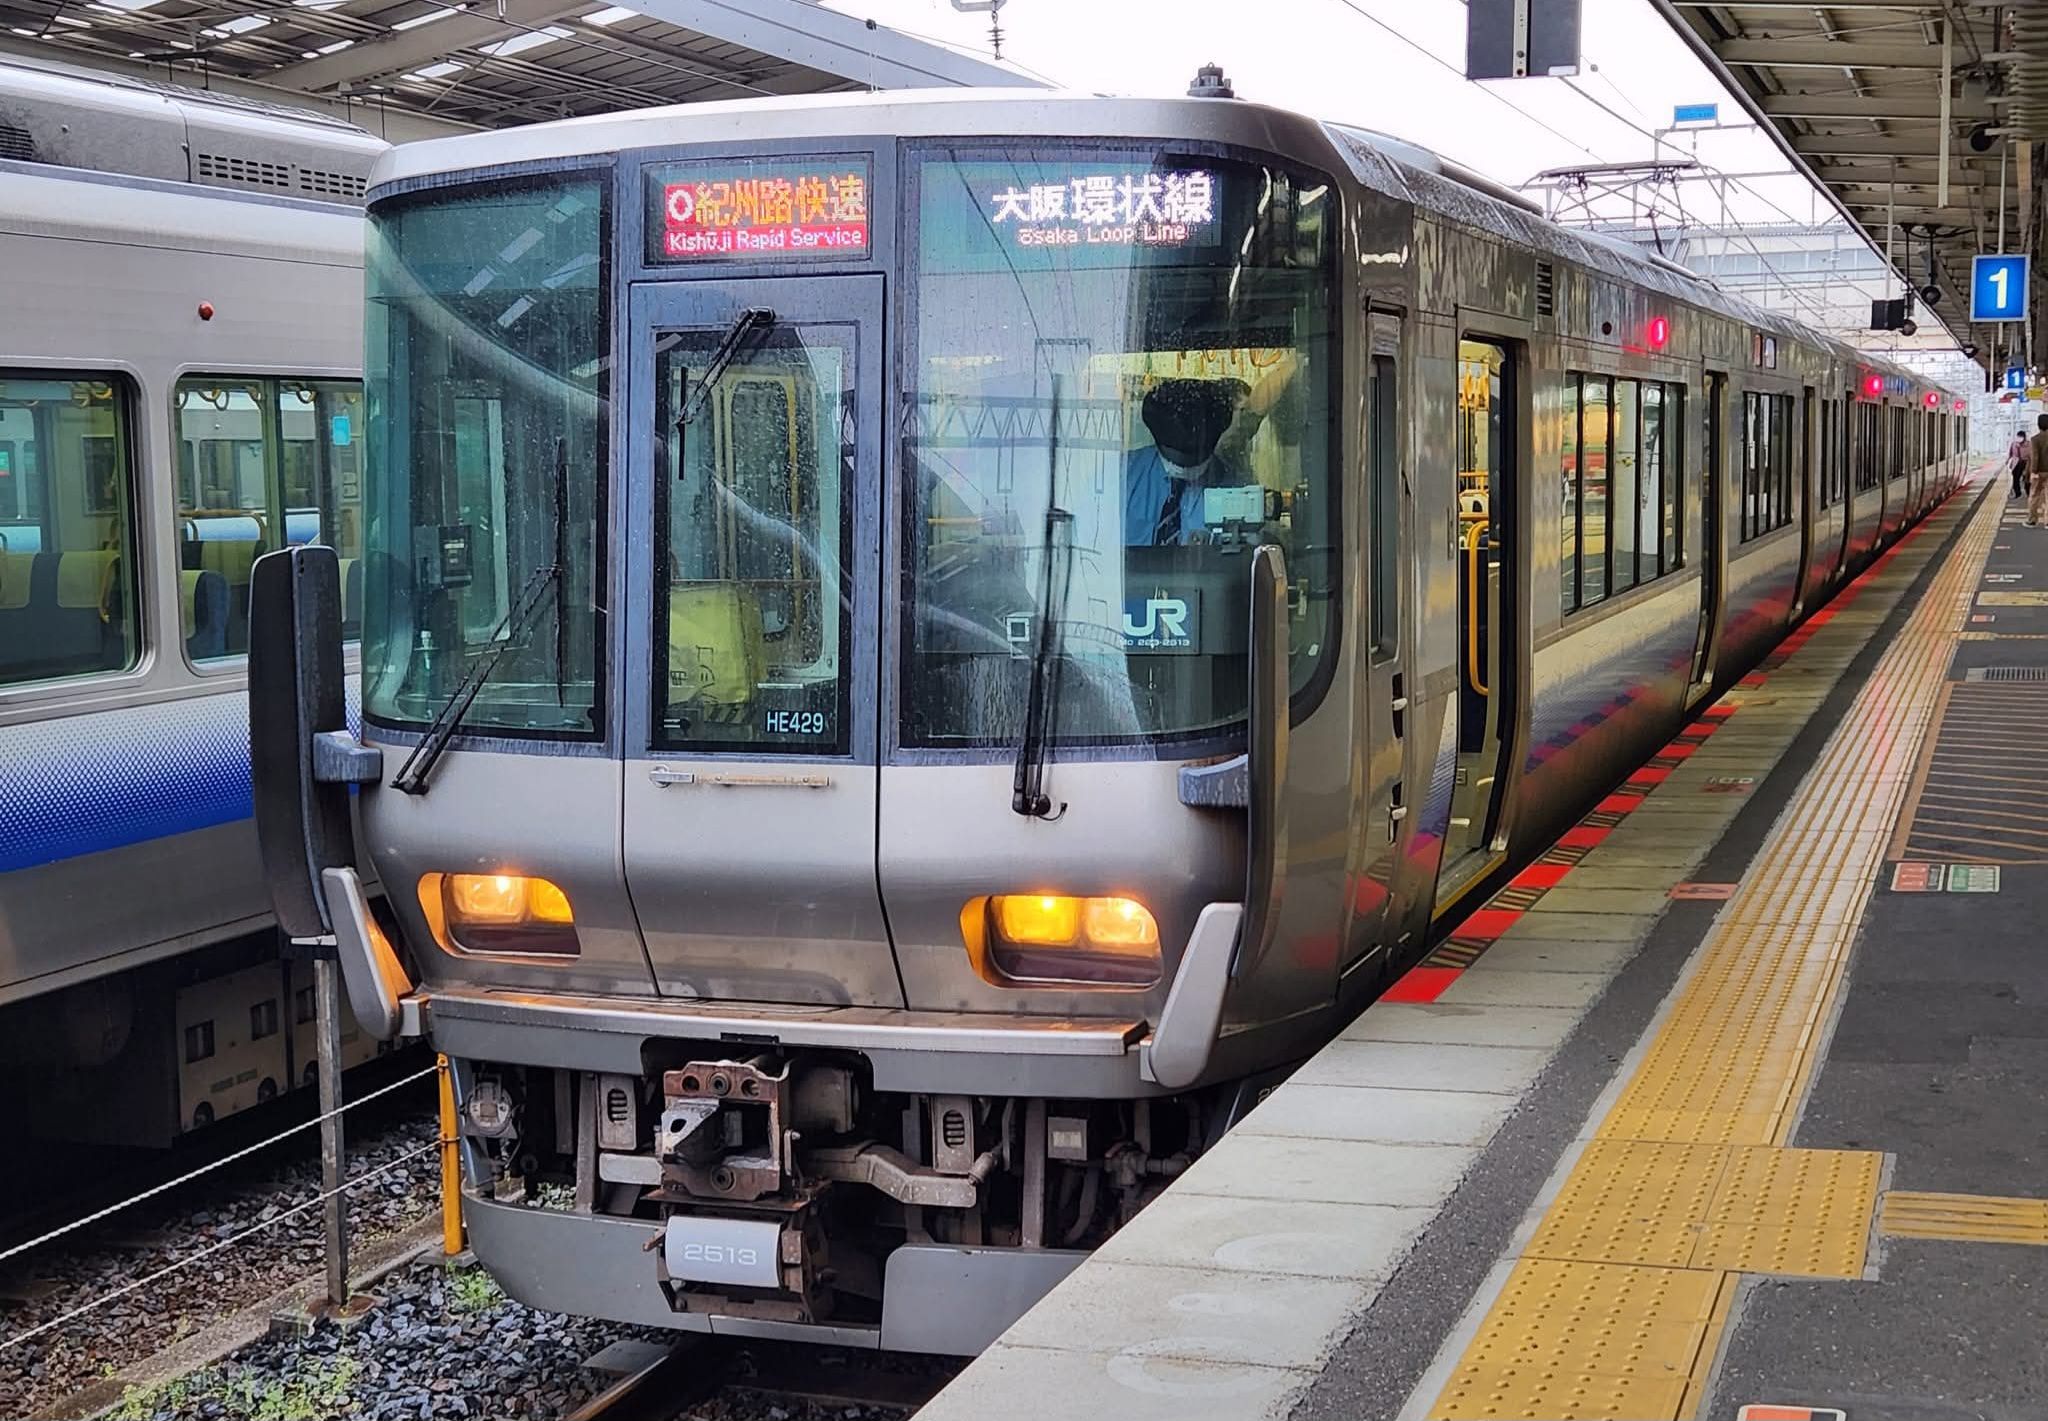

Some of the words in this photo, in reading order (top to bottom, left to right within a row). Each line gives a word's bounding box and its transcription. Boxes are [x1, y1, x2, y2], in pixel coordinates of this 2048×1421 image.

[696, 175, 866, 226] 紀州路快速
[991, 170, 1213, 225] 大阪環状線
[737, 228, 785, 249] Rapid
[790, 227, 862, 246] Service
[1087, 227, 1134, 244] Loop
[1143, 223, 1186, 242] Line
[1989, 267, 2008, 308] 1
[2011, 371, 2020, 386] 1
[1122, 599, 1187, 637] JR
[766, 711, 824, 733] HE429
[684, 1243, 757, 1265] 2513
